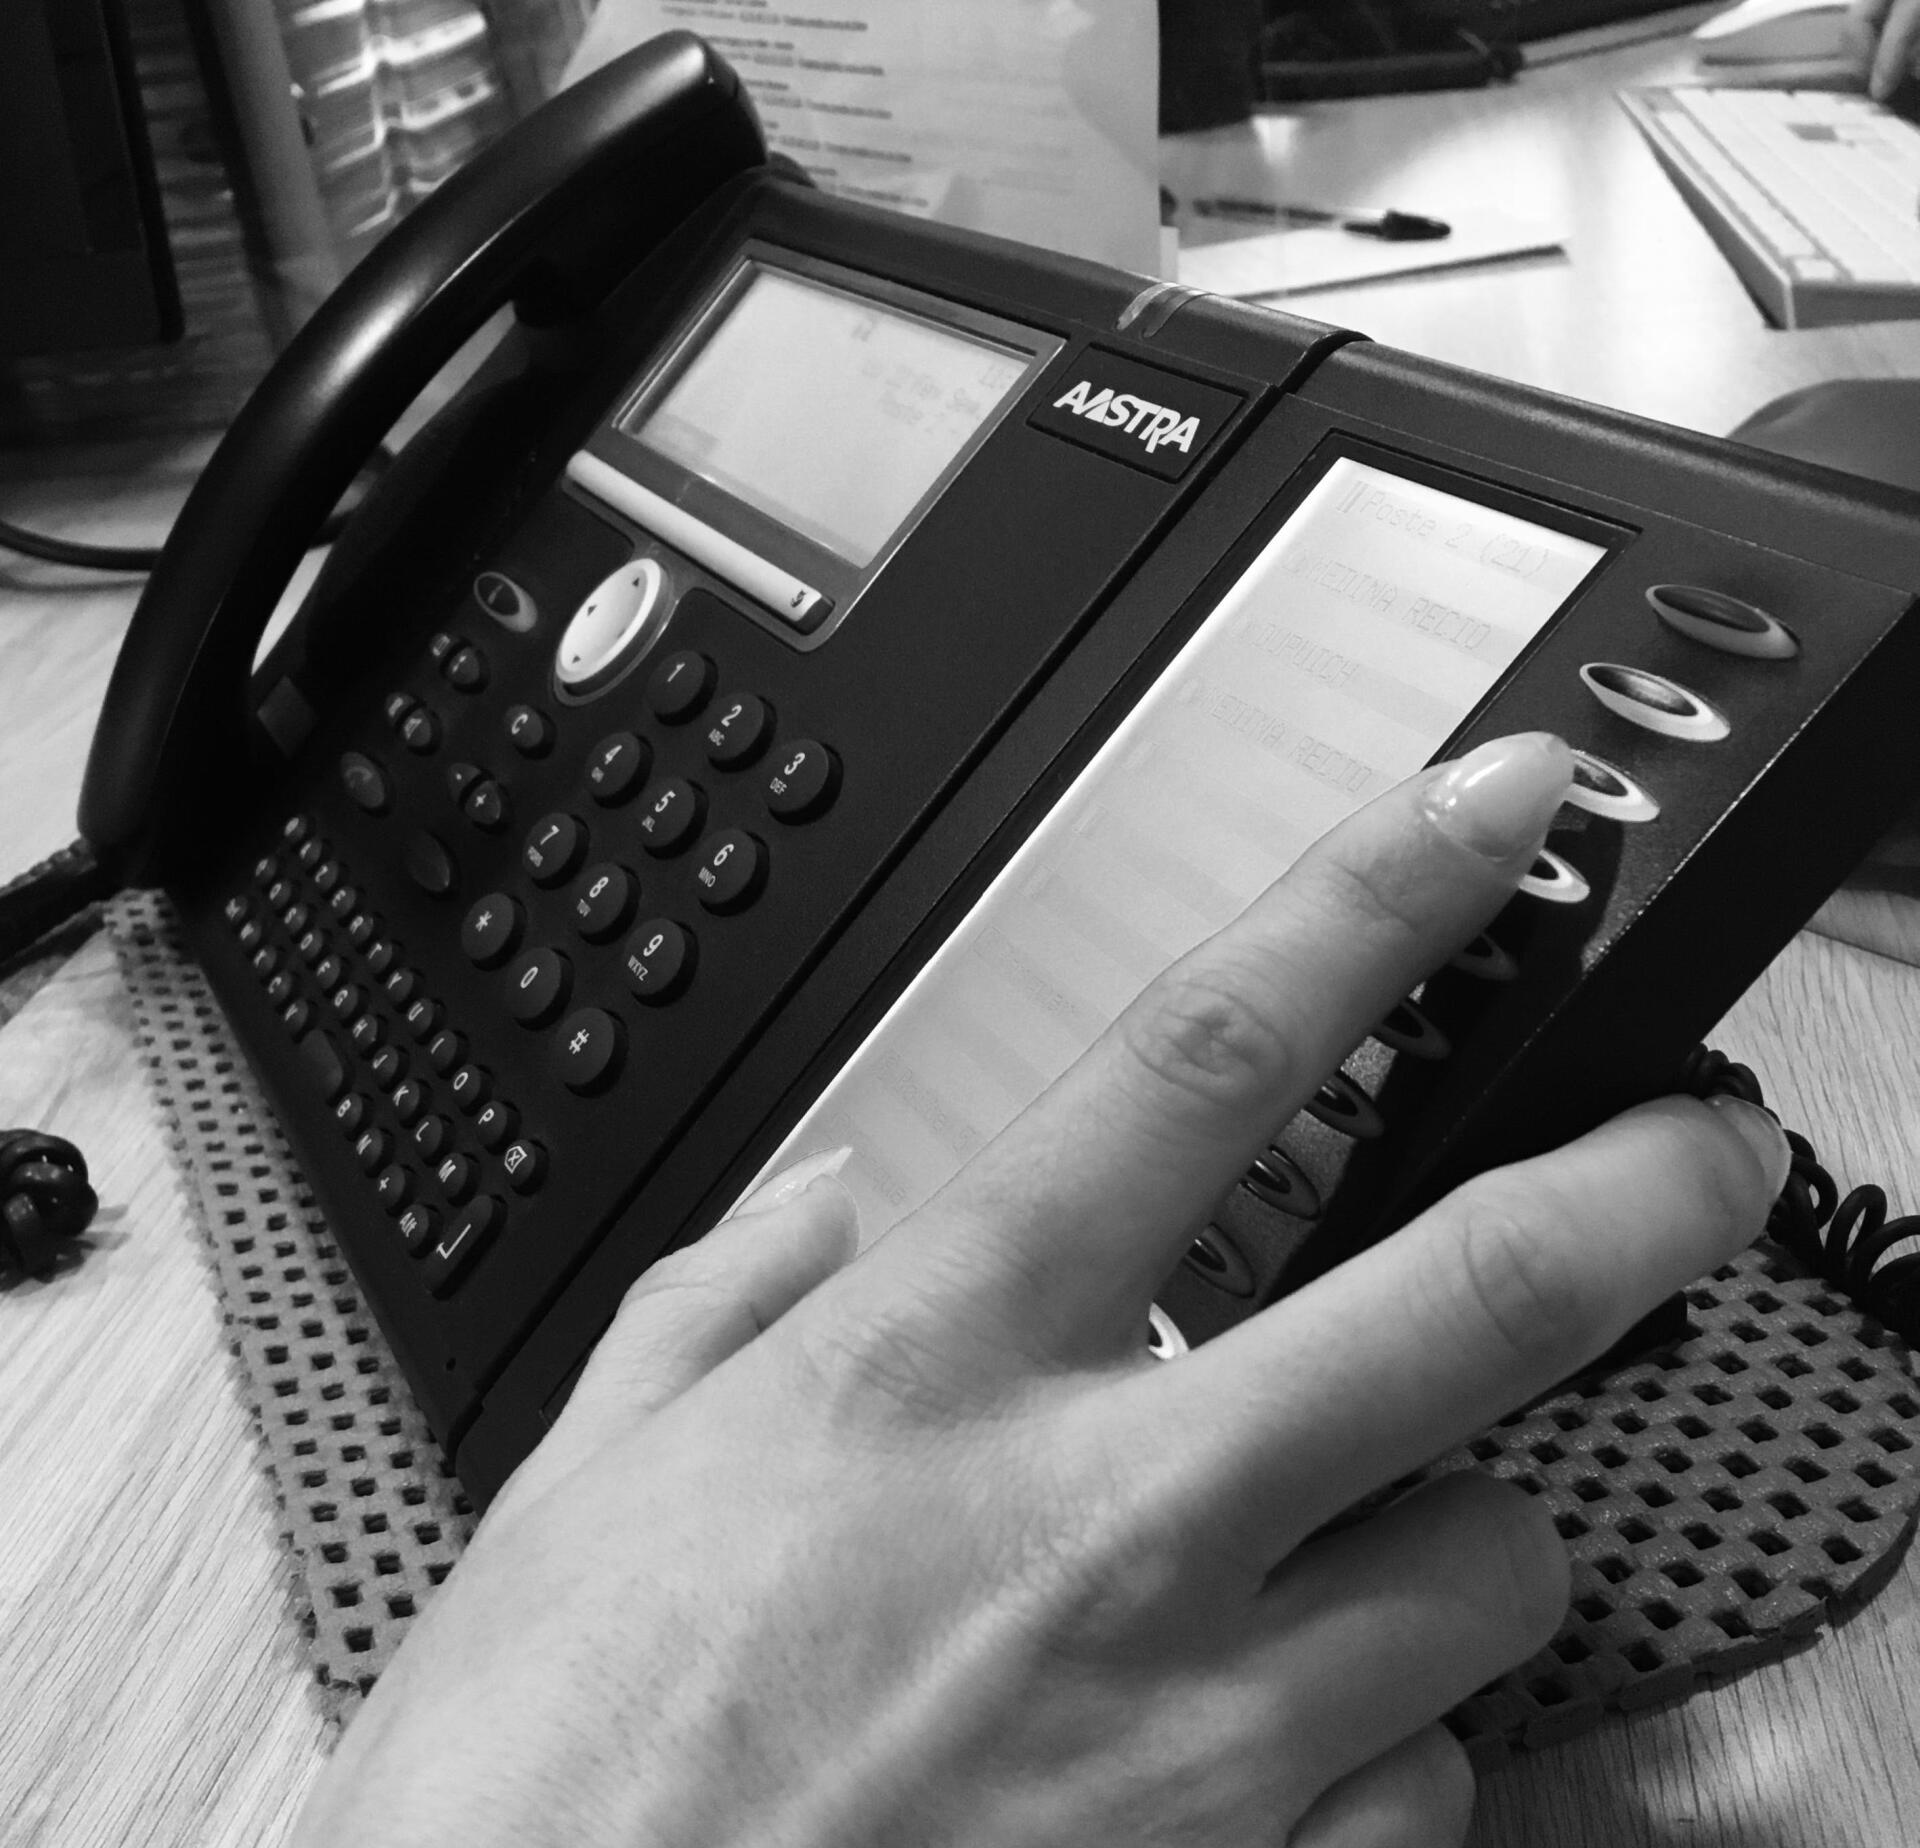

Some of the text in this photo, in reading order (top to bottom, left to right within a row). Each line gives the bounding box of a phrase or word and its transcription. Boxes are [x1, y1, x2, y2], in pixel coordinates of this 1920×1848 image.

[1052, 380, 1200, 454] AASTRA
[1358, 490, 1437, 538] Poste
[1478, 532, 1550, 579] (21)
[667, 662, 686, 682] 1
[511, 713, 529, 735] C
[721, 704, 743, 727] 2
[604, 745, 623, 765] 4
[784, 752, 806, 775] 3
[767, 776, 789, 796] DEF
[654, 790, 676, 813] 5
[540, 824, 560, 845] 7
[713, 843, 735, 866] 6
[589, 876, 609, 898] 8
[332, 889, 347, 907] E
[643, 934, 664, 957] 9
[388, 972, 403, 989] Y
[408, 1002, 425, 1022] U
[372, 1054, 388, 1070] J
[393, 1085, 409, 1106] K
[337, 1098, 352, 1118] B
[478, 1108, 495, 1125] P
[415, 1121, 430, 1142] L
